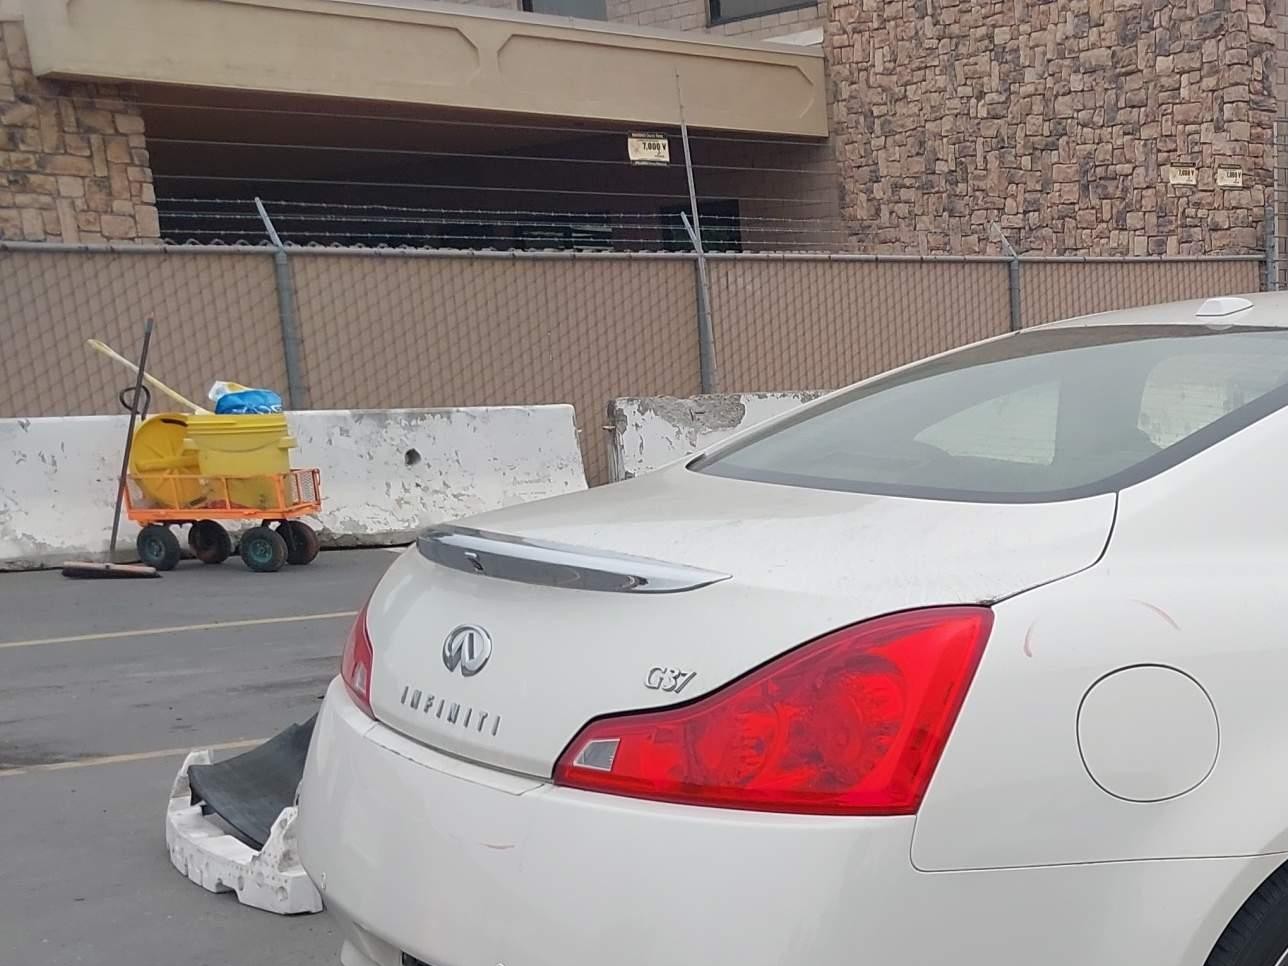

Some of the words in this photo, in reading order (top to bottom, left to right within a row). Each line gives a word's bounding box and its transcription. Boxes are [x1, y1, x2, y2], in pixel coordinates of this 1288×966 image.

[642, 142, 661, 151] 7,000
[643, 666, 698, 694] G37
[400, 685, 501, 737] INFINITI
